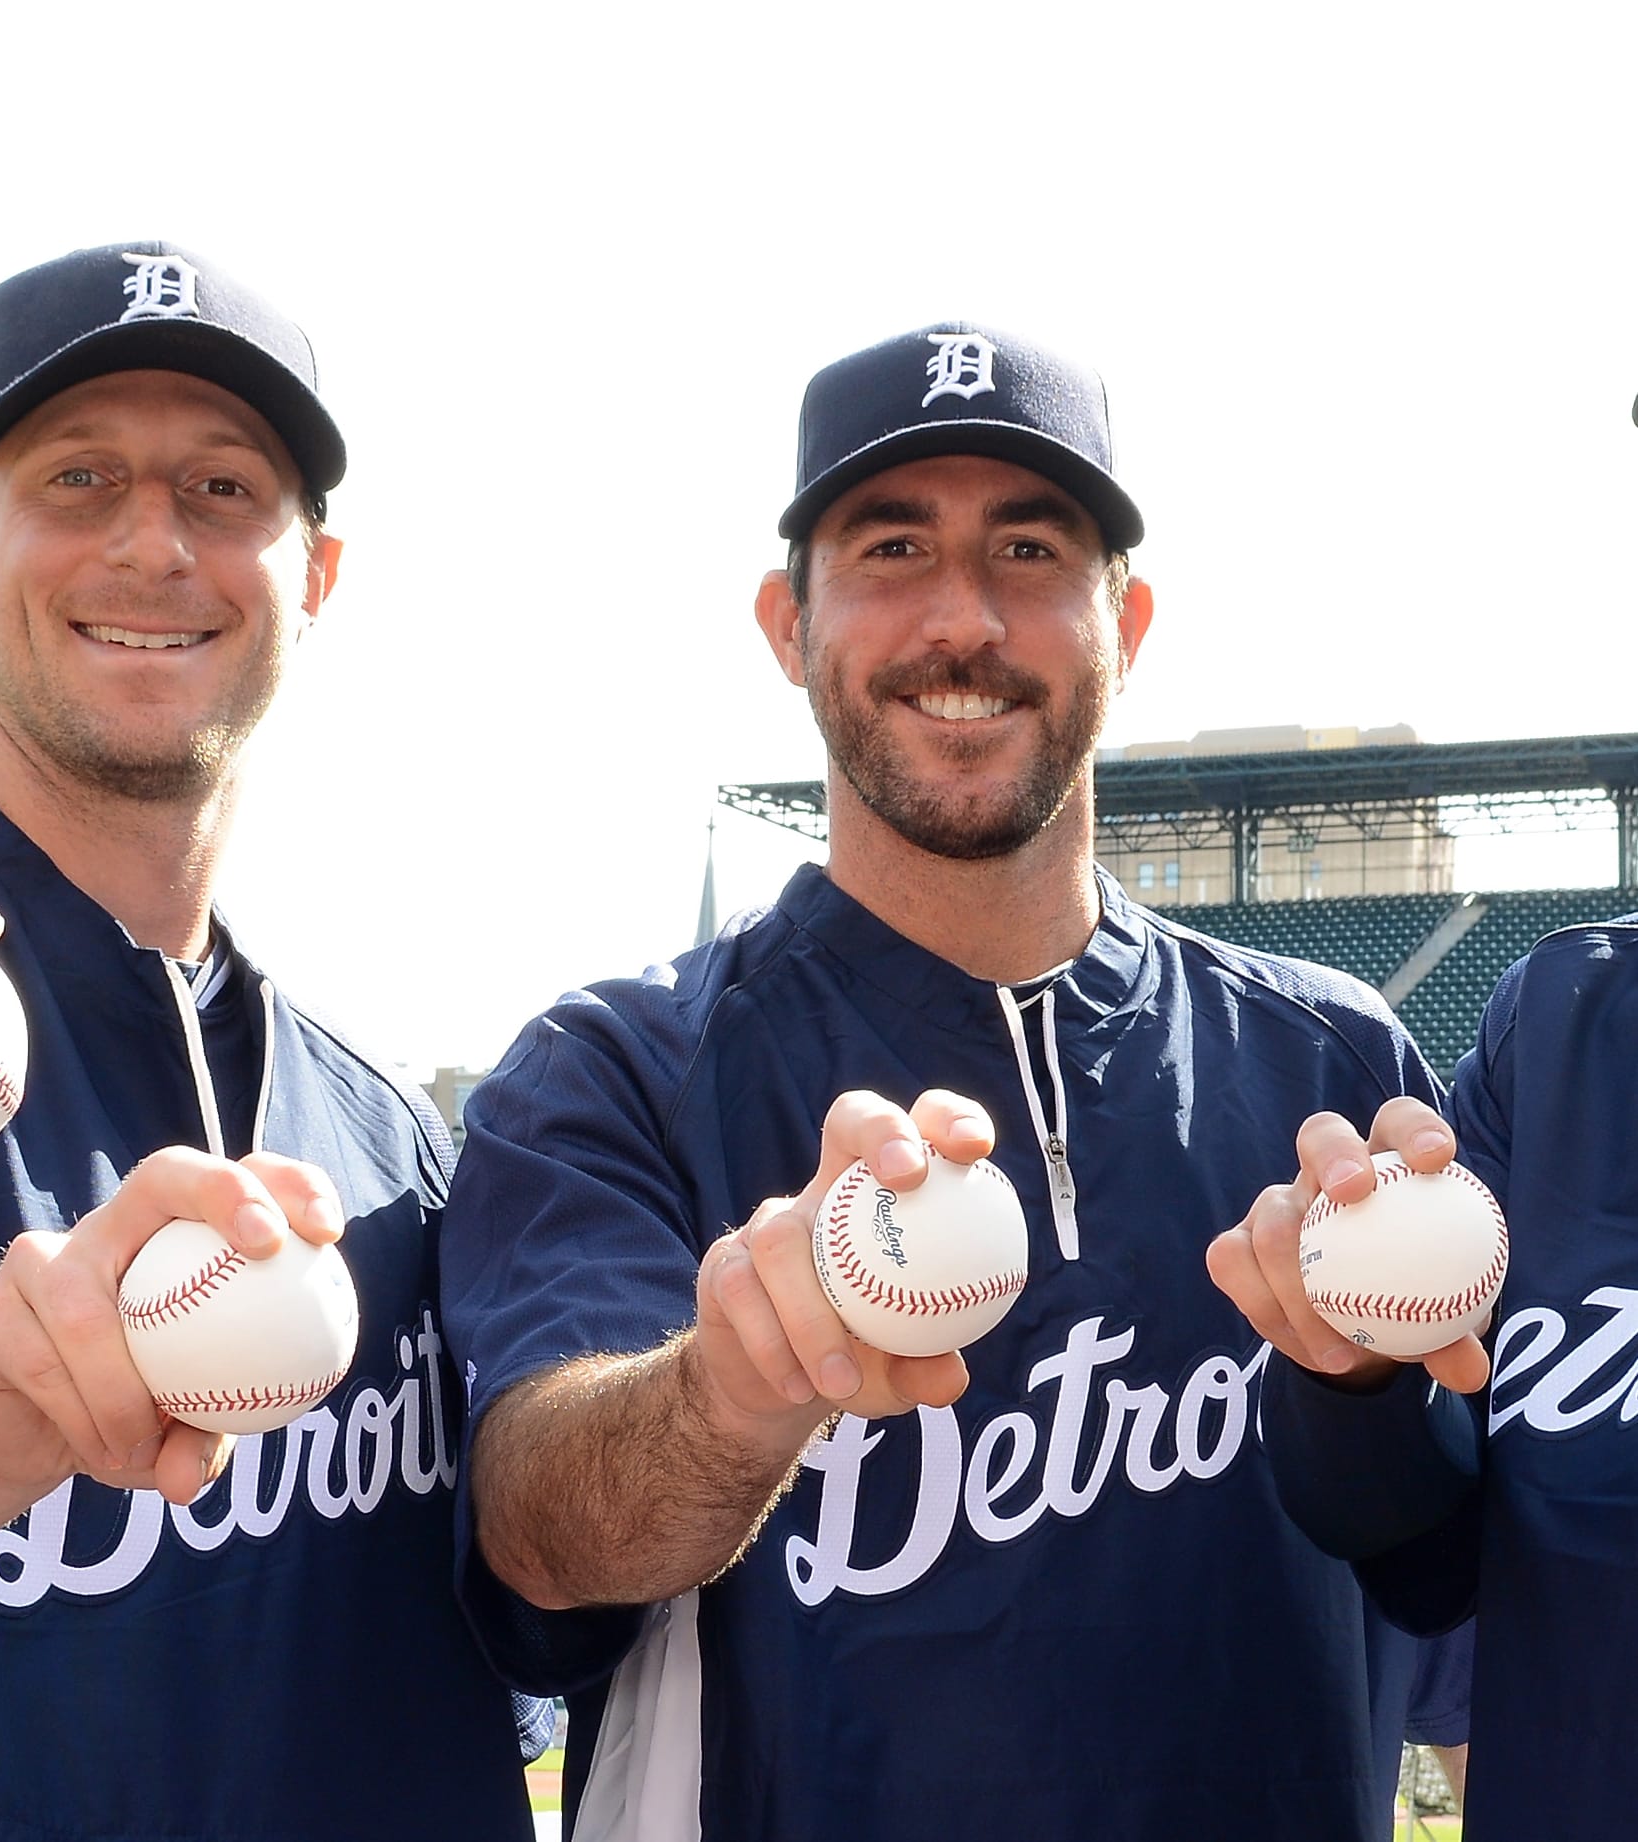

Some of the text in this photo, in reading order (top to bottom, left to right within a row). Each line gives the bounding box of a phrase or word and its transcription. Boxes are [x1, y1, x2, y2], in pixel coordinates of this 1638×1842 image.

[119, 252, 200, 324] D
[922, 332, 997, 408] D
[873, 1188, 909, 1268] Rawlings
